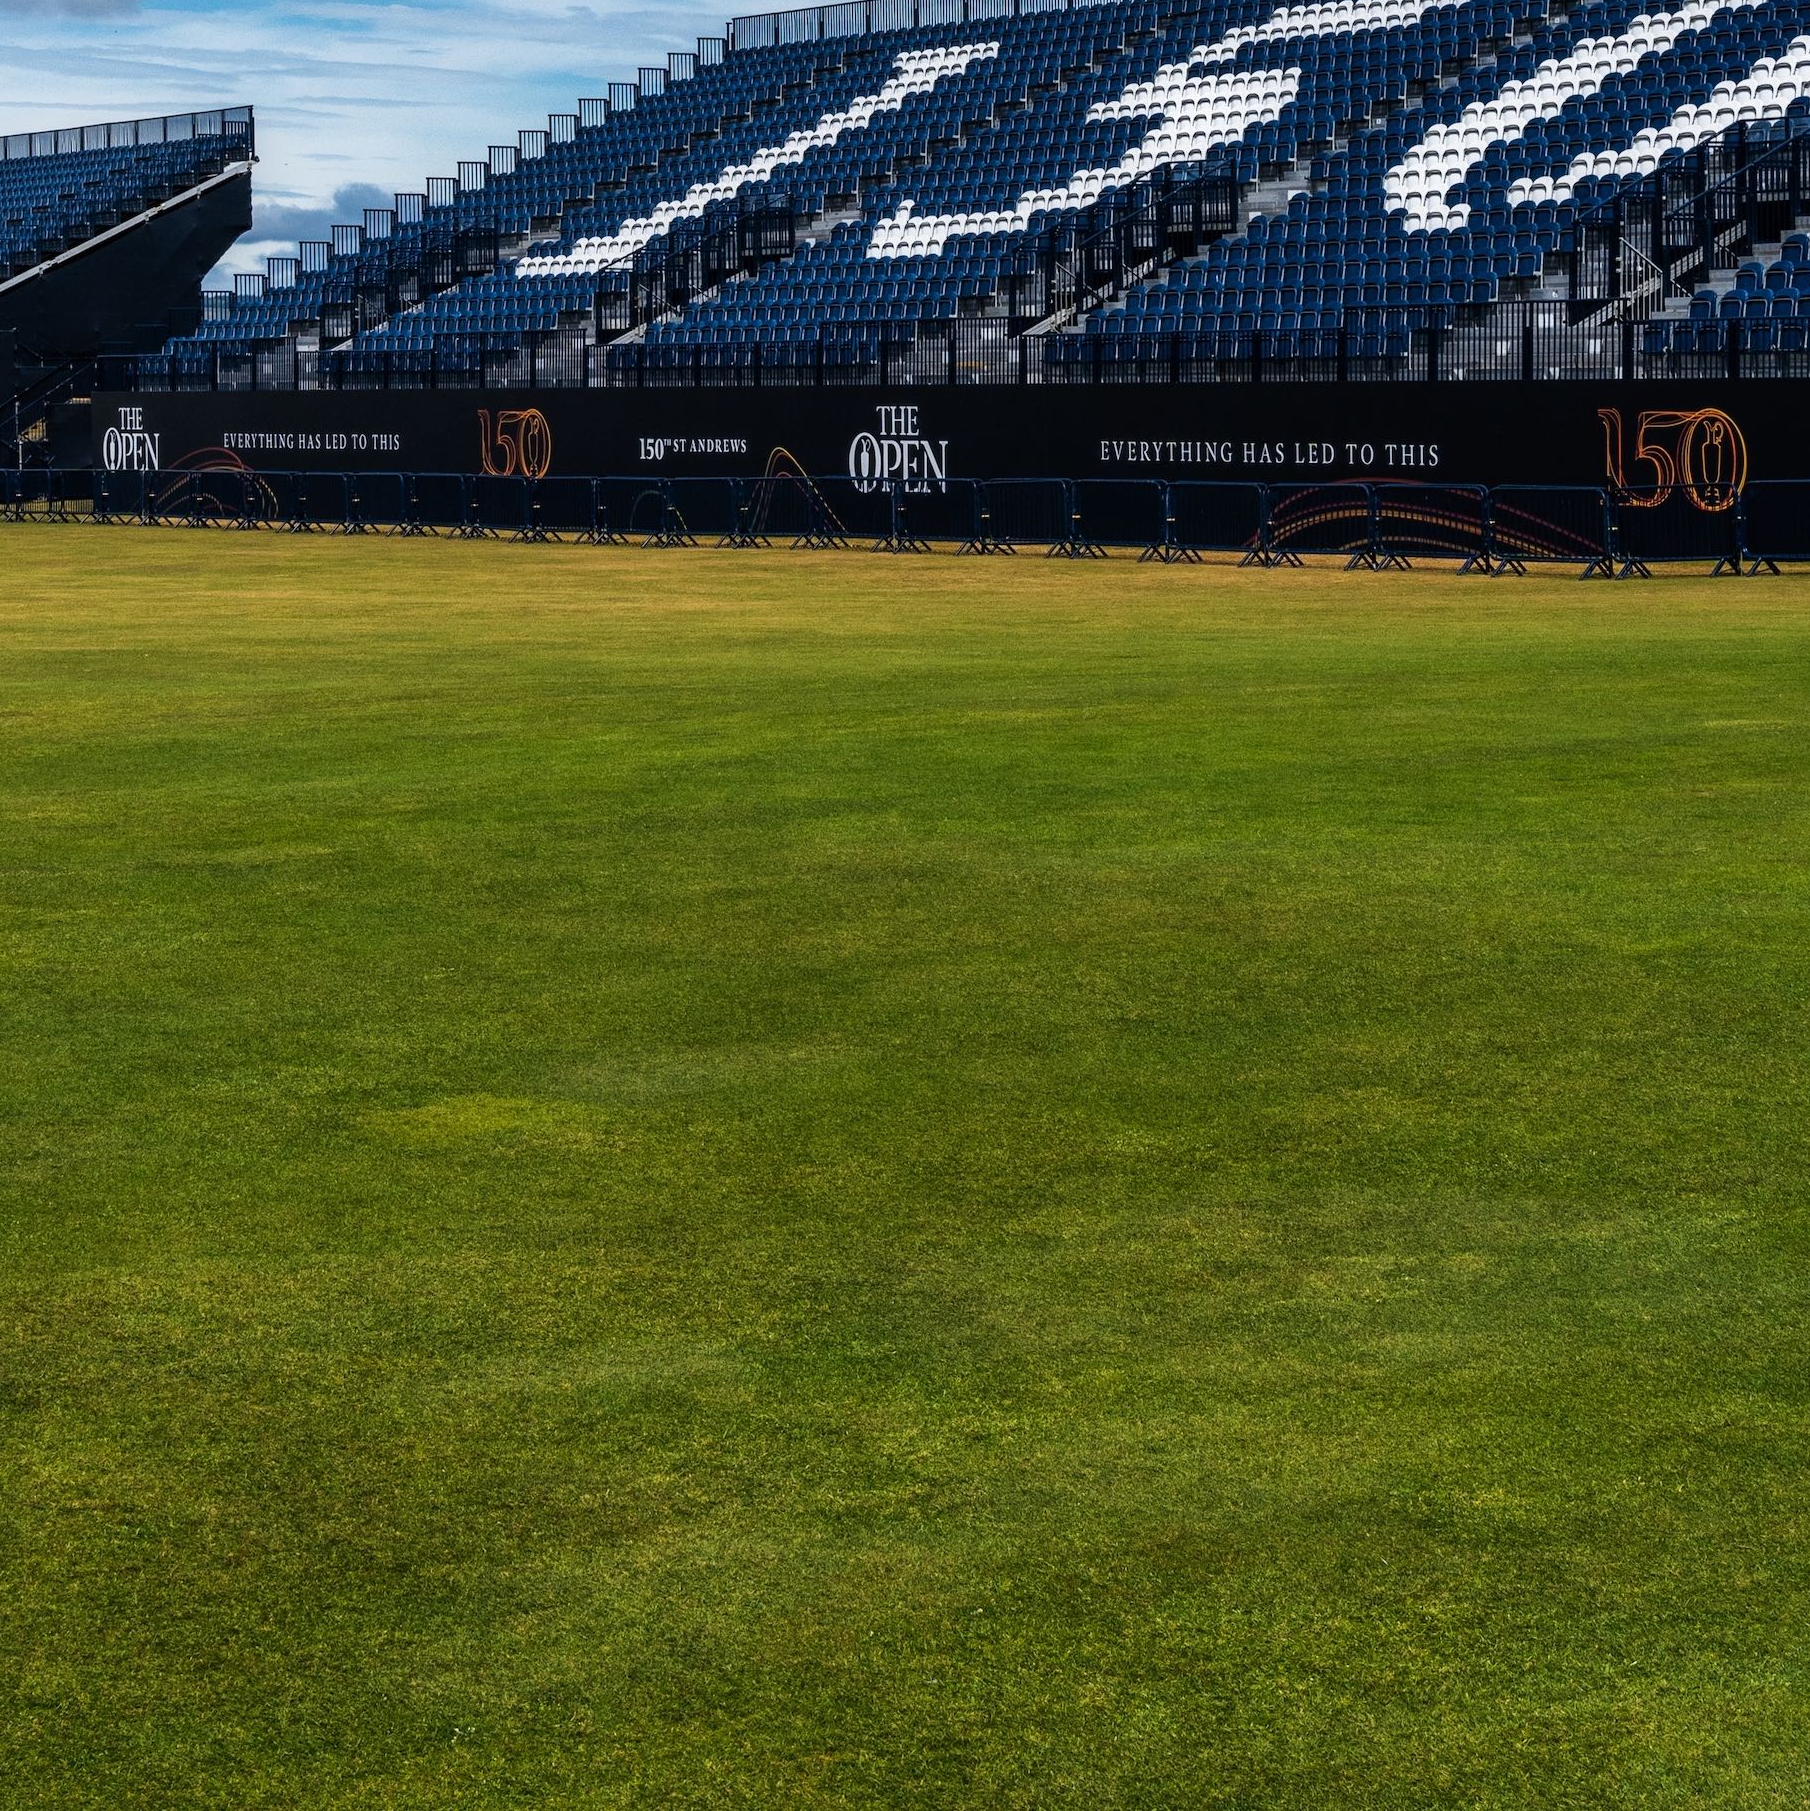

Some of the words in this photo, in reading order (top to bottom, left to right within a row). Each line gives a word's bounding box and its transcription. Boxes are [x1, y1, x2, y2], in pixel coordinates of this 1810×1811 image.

[118, 407, 143, 430] THE
[876, 406, 919, 436] THE
[103, 427, 160, 472] OPEN
[223, 433, 294, 449] EVERYTHING
[298, 434, 321, 449] HAS
[325, 434, 347, 449] LED
[352, 434, 367, 450] TO
[372, 434, 400, 451] THIS
[477, 408, 551, 478] 150
[673, 439, 687, 452] ST
[690, 439, 747, 453] ANDREWS
[1100, 441, 1233, 463] EVERYTHING
[1243, 442, 1285, 464] HAS
[1295, 443, 1335, 464] LED
[1345, 443, 1374, 465] TO
[1385, 444, 1439, 467] THIS
[849, 432, 948, 493] OPEN
[1597, 408, 1747, 512] 150
